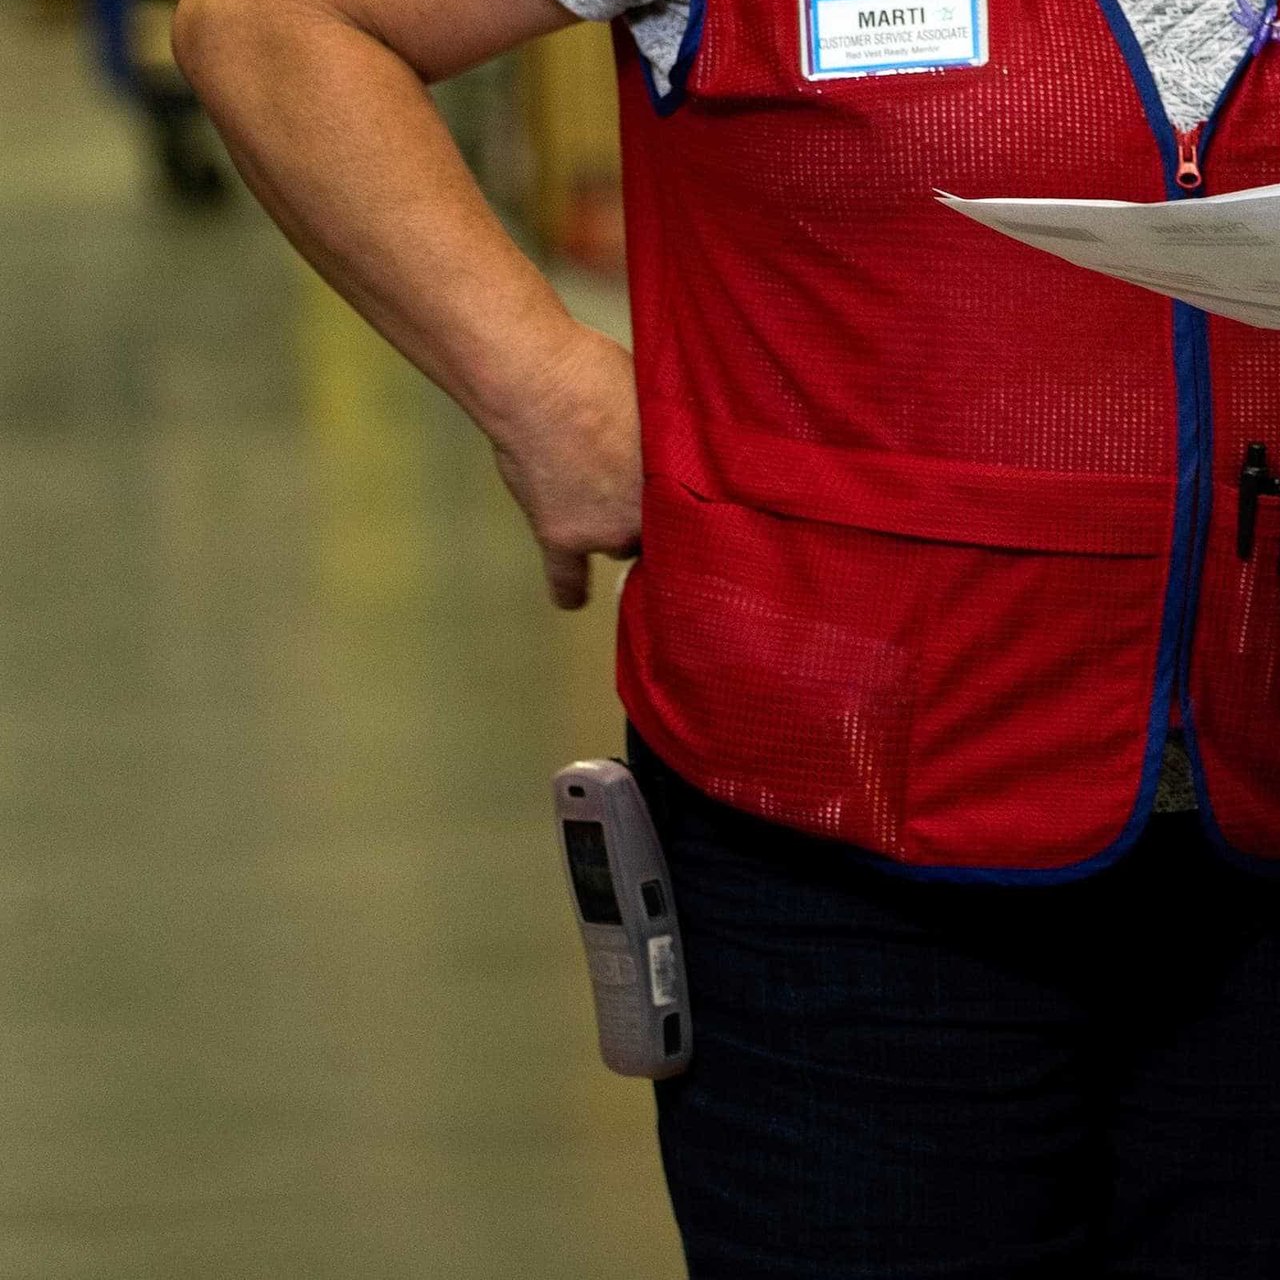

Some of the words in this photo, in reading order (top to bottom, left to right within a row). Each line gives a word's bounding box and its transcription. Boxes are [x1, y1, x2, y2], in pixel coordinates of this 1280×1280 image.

[858, 6, 926, 29] MARTI
[820, 33, 872, 51] CUSTOMER
[874, 30, 912, 45] SERVICE
[916, 26, 969, 41] ASSOCIATE
